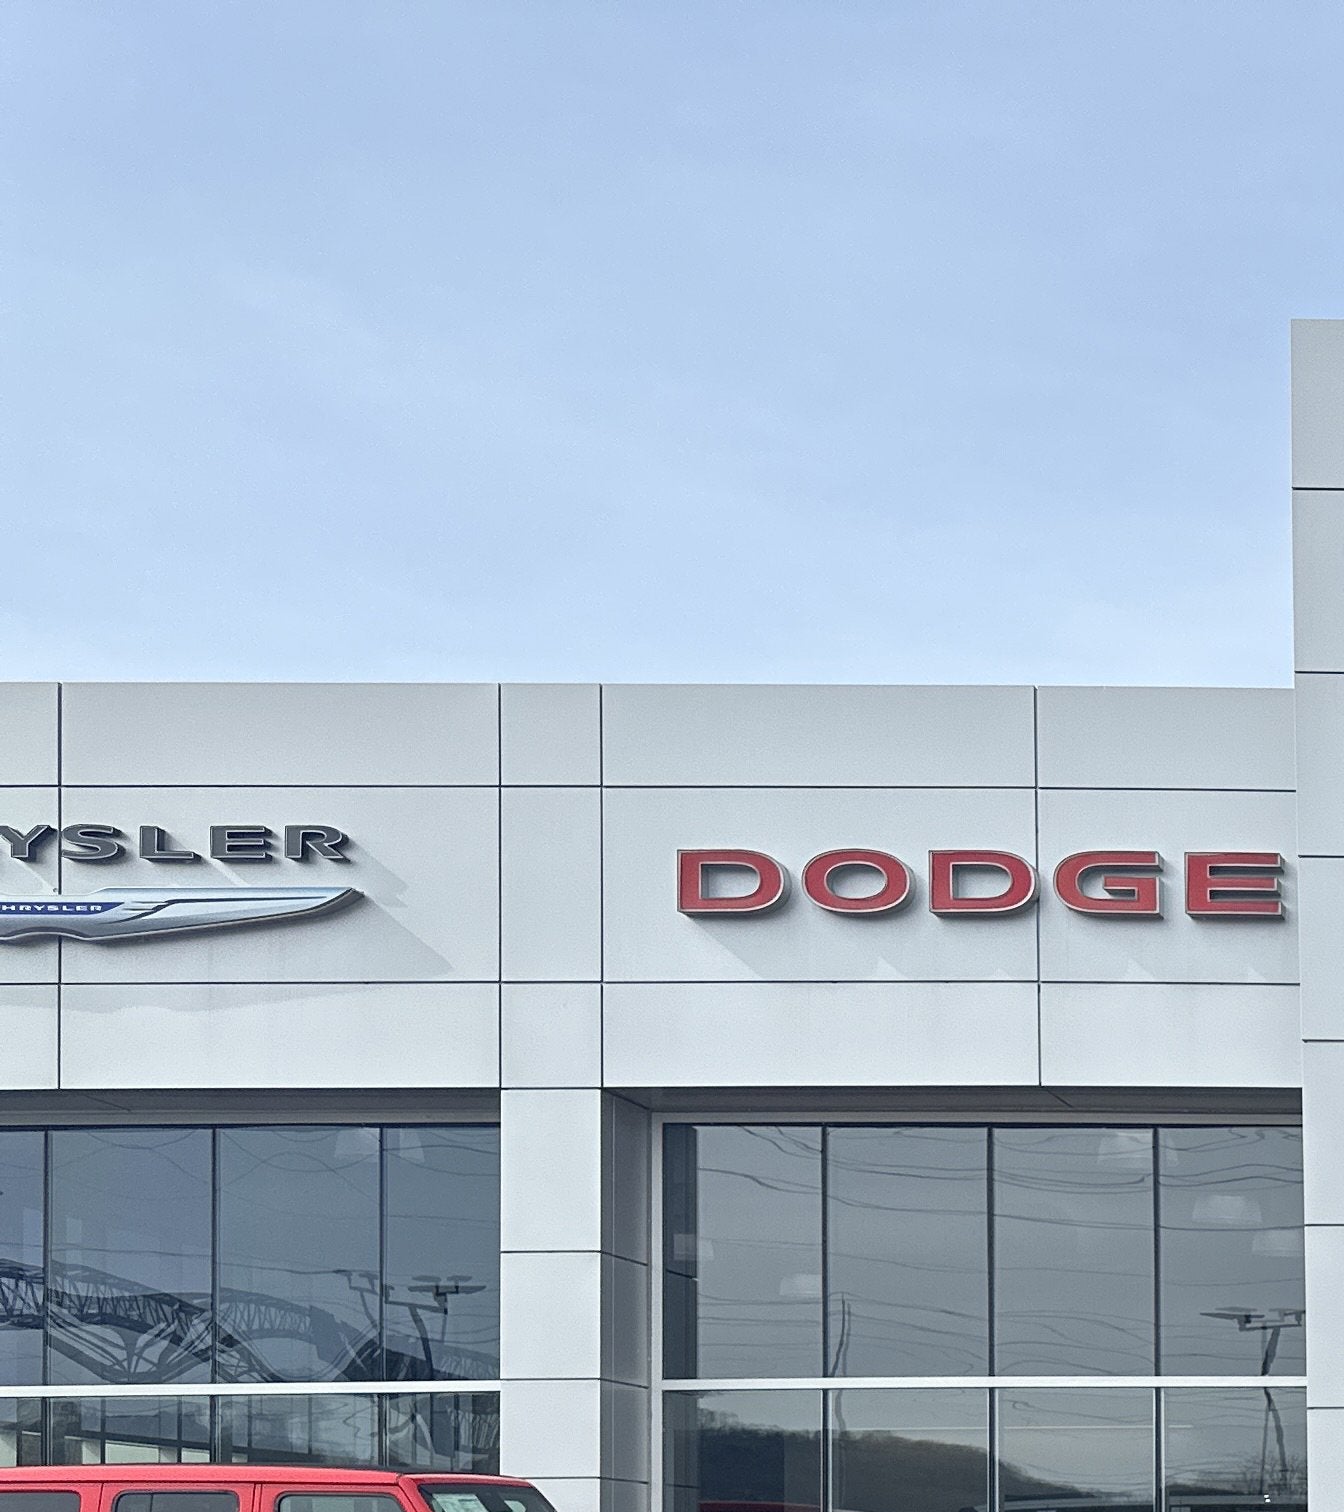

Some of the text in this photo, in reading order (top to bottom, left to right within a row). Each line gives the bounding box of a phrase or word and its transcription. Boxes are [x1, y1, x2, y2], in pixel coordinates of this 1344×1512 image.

[0, 823, 352, 864] YSLER
[676, 848, 1286, 919] DODGE
[0, 904, 102, 912] HRYSLER
